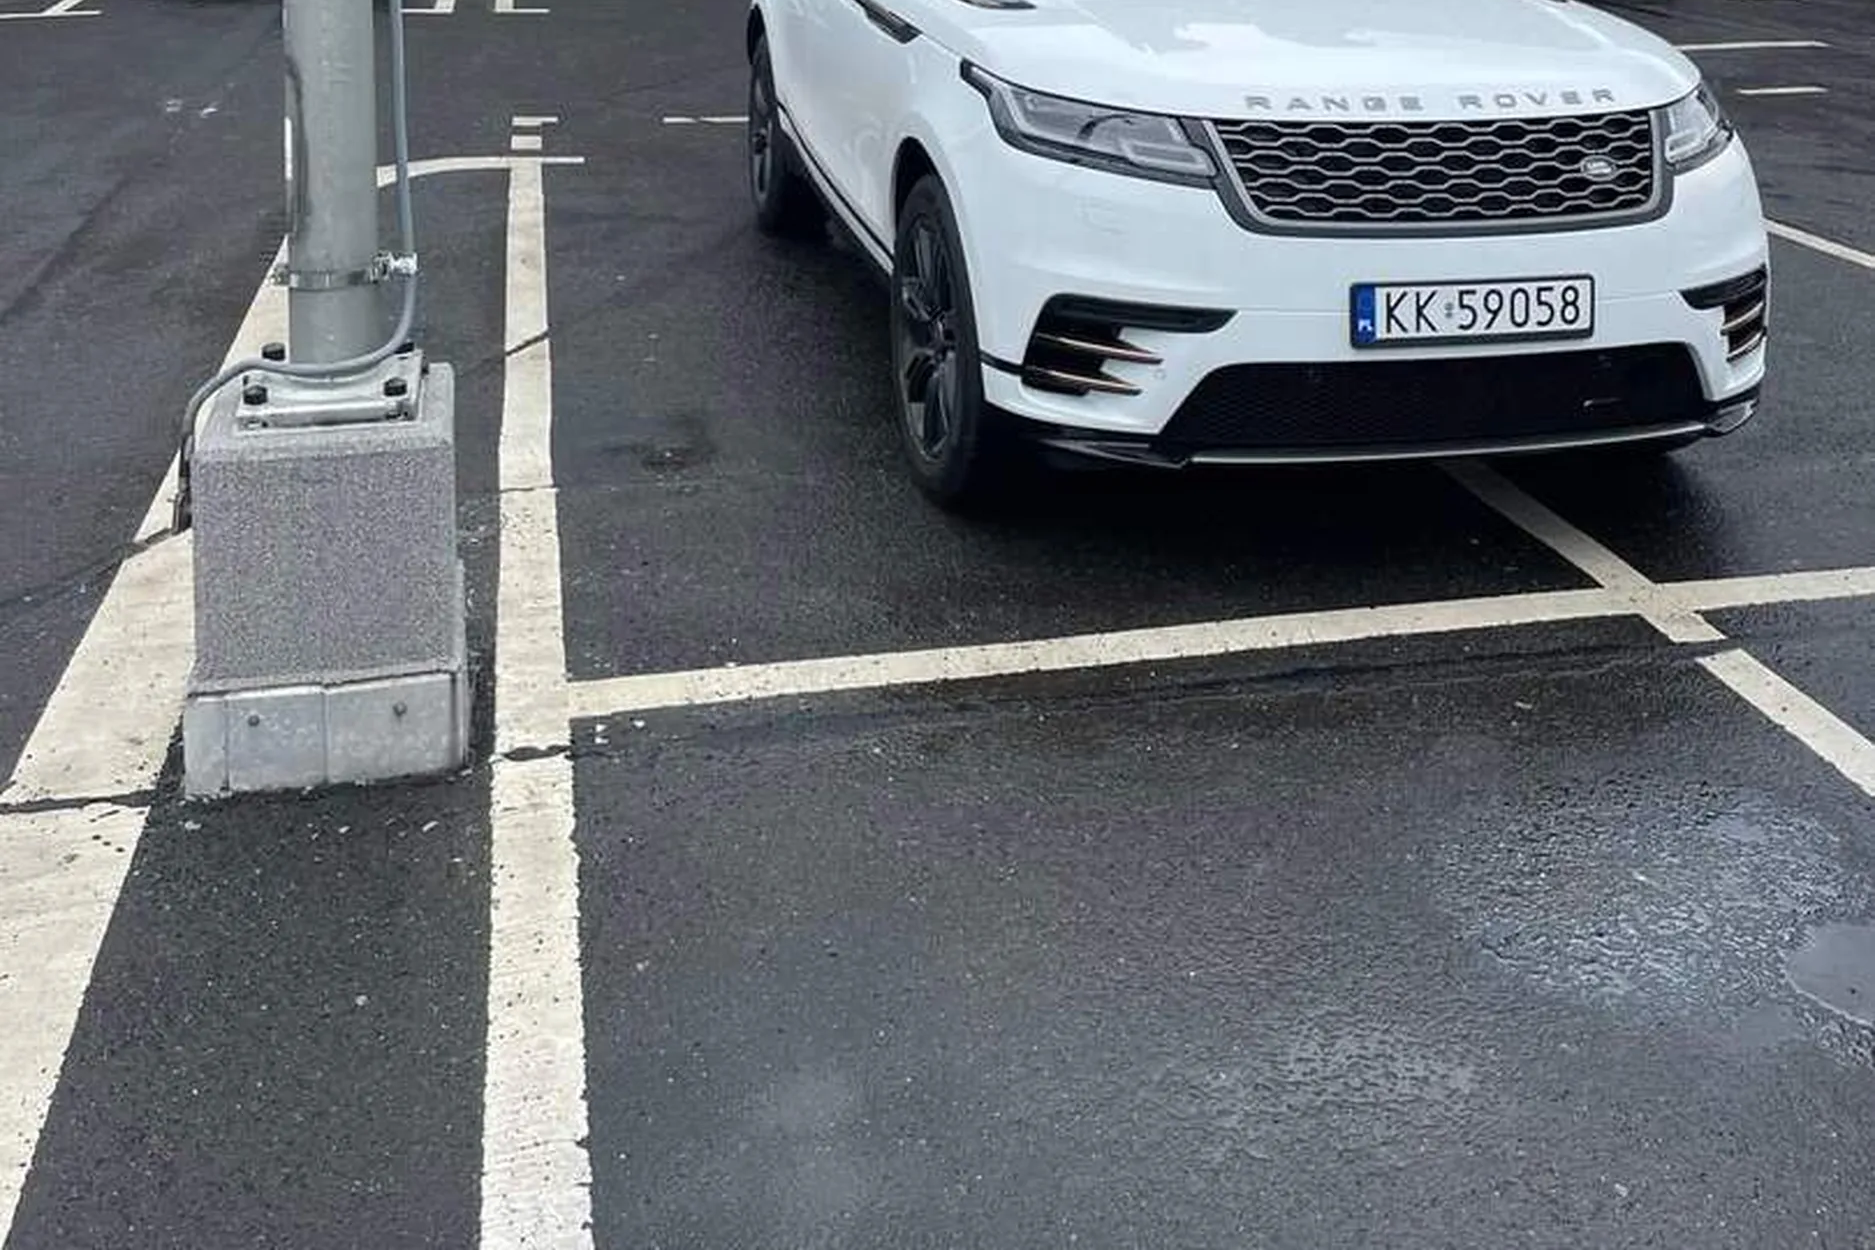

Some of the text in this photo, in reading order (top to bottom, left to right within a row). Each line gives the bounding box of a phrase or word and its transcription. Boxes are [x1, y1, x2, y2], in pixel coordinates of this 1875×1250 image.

[1244, 88, 1615, 111] RANGE ROVER
[1385, 285, 1580, 334] KK 59058
